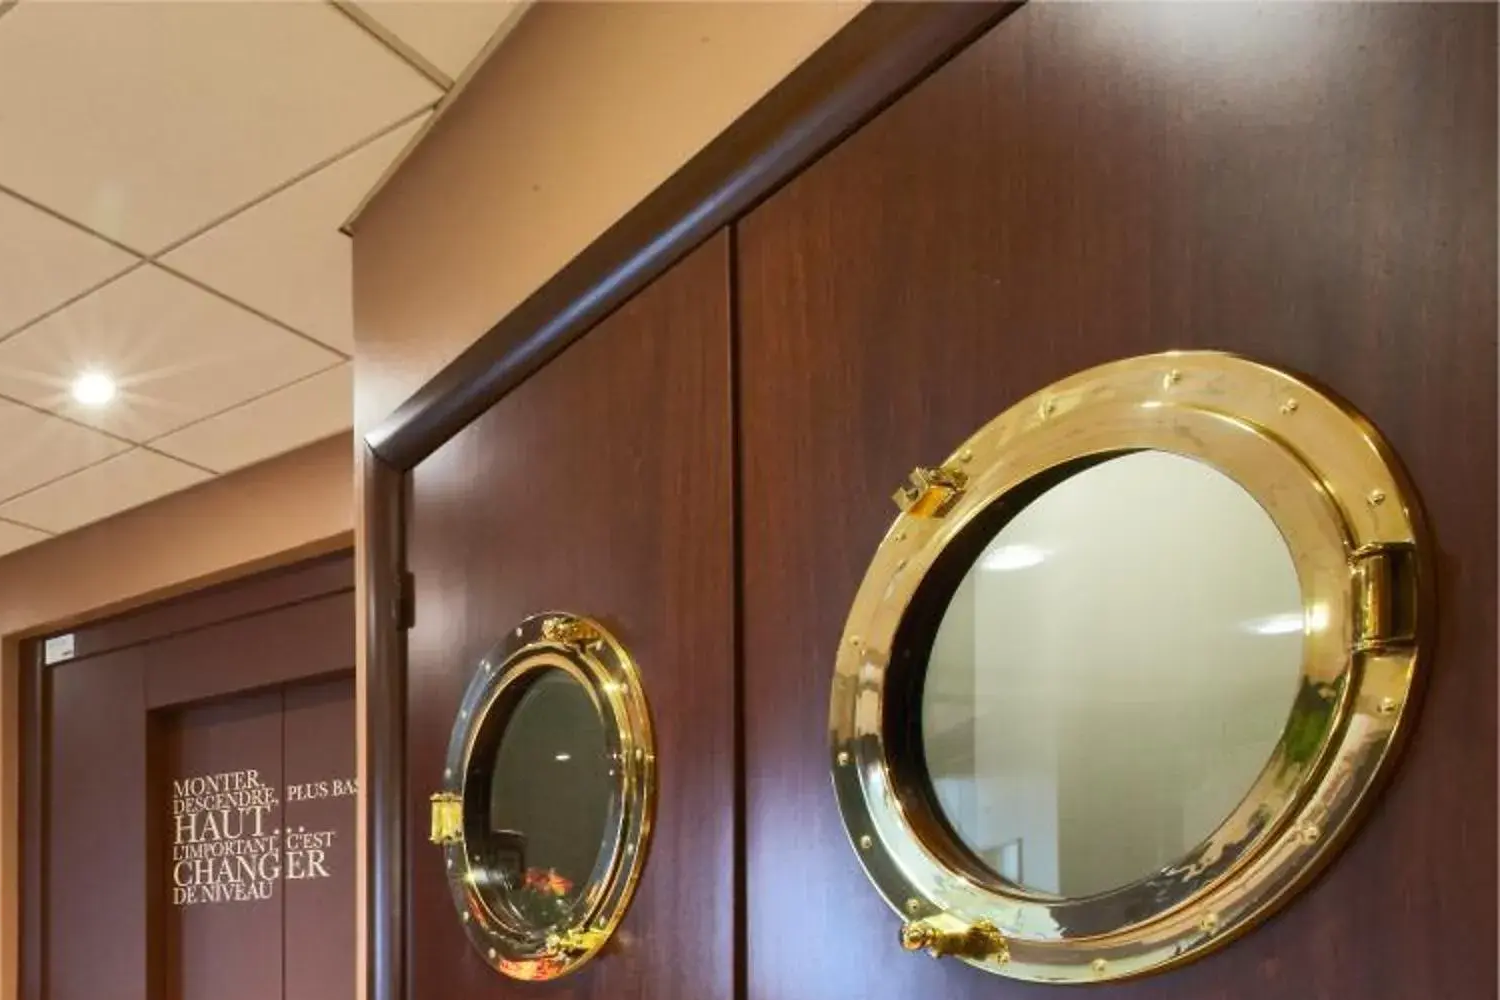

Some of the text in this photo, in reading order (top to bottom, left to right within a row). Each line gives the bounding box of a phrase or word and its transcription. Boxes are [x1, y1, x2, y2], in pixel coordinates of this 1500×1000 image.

[287, 781, 329, 801] PLUS
[286, 831, 337, 850] C'EST
[173, 880, 273, 905] DE NIVEAU
